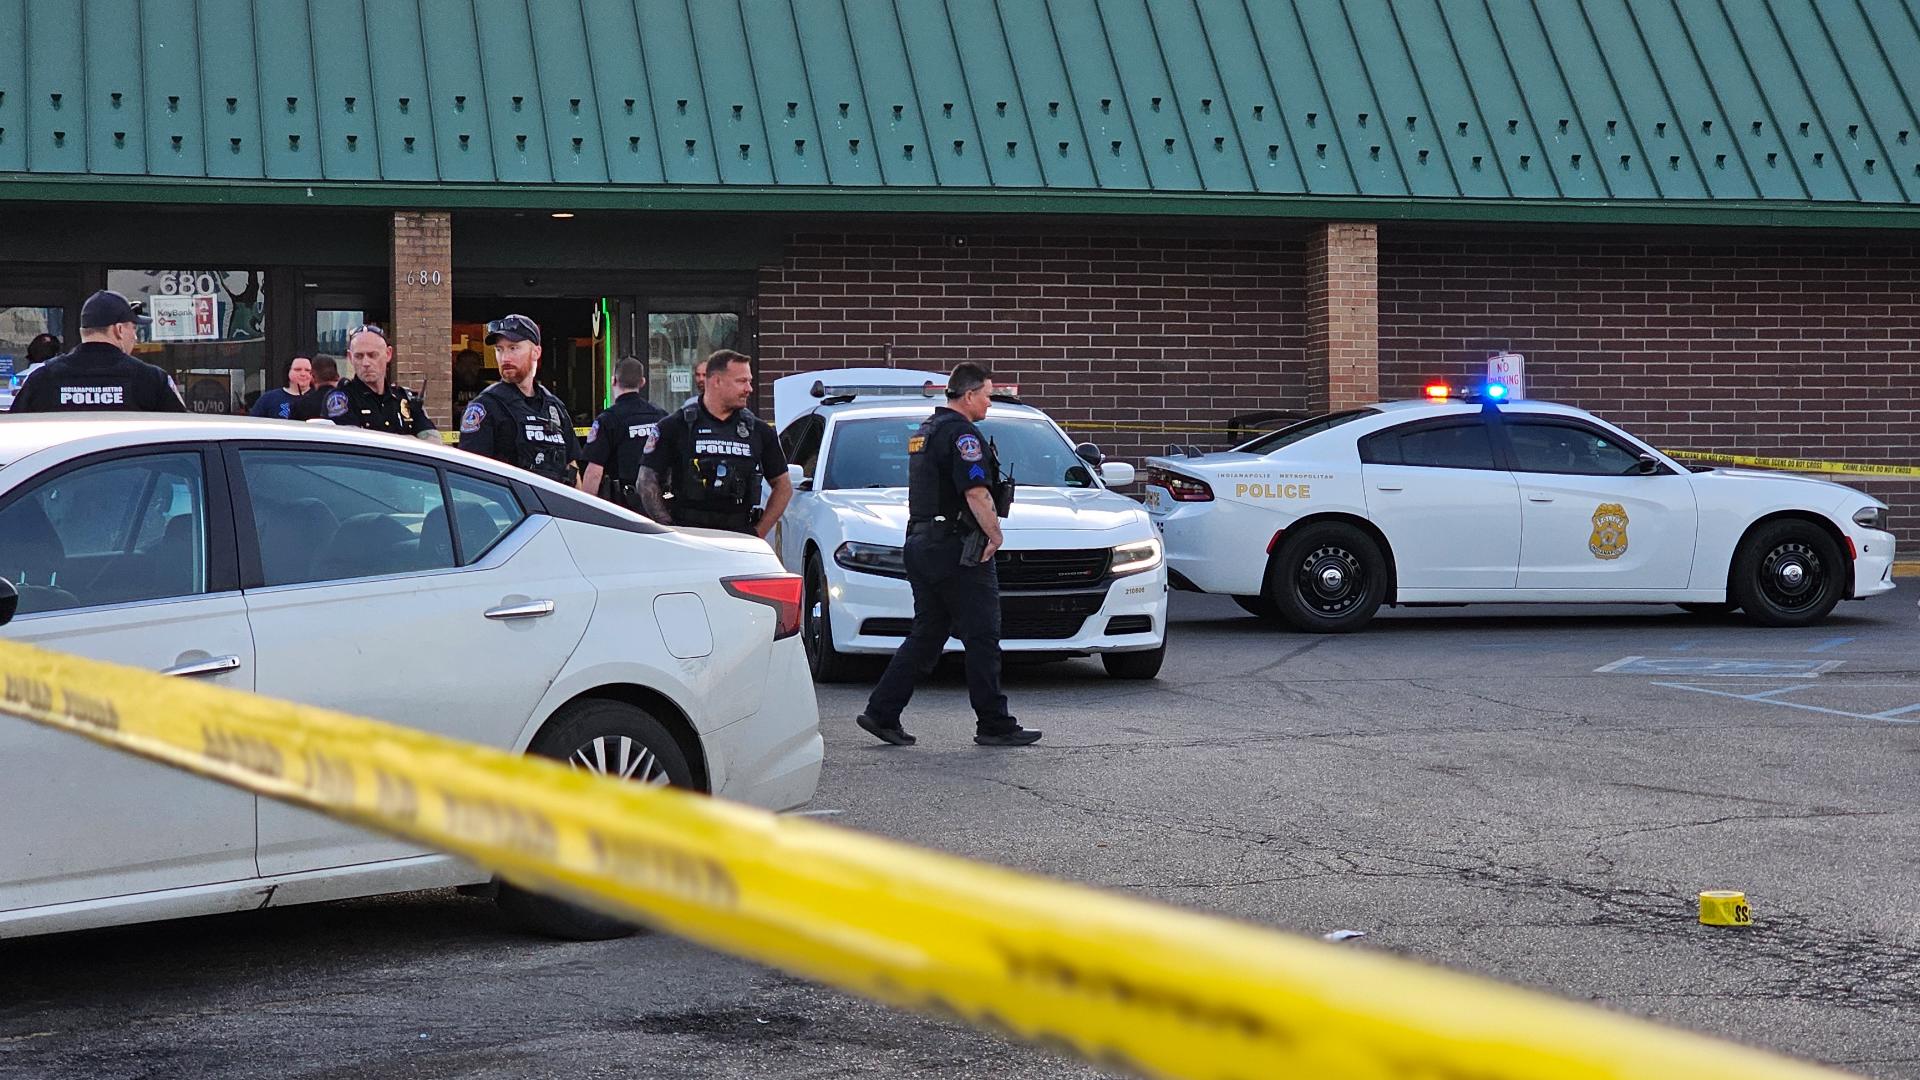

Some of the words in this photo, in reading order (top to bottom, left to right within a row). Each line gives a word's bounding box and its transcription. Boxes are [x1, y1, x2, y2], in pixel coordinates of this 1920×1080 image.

[408, 270, 440, 285] 680
[160, 274, 214, 295] 680
[158, 309, 193, 317] KeyBank
[199, 300, 211, 333] ATM
[1497, 362, 1509, 373] NO
[61, 392, 124, 404] POLICE
[525, 430, 565, 444] POLICE
[695, 444, 751, 456] POLICE
[1859, 464, 1875, 472] SCENE
[1895, 466, 1912, 474] CROSS
[1236, 483, 1311, 498] POLICE
